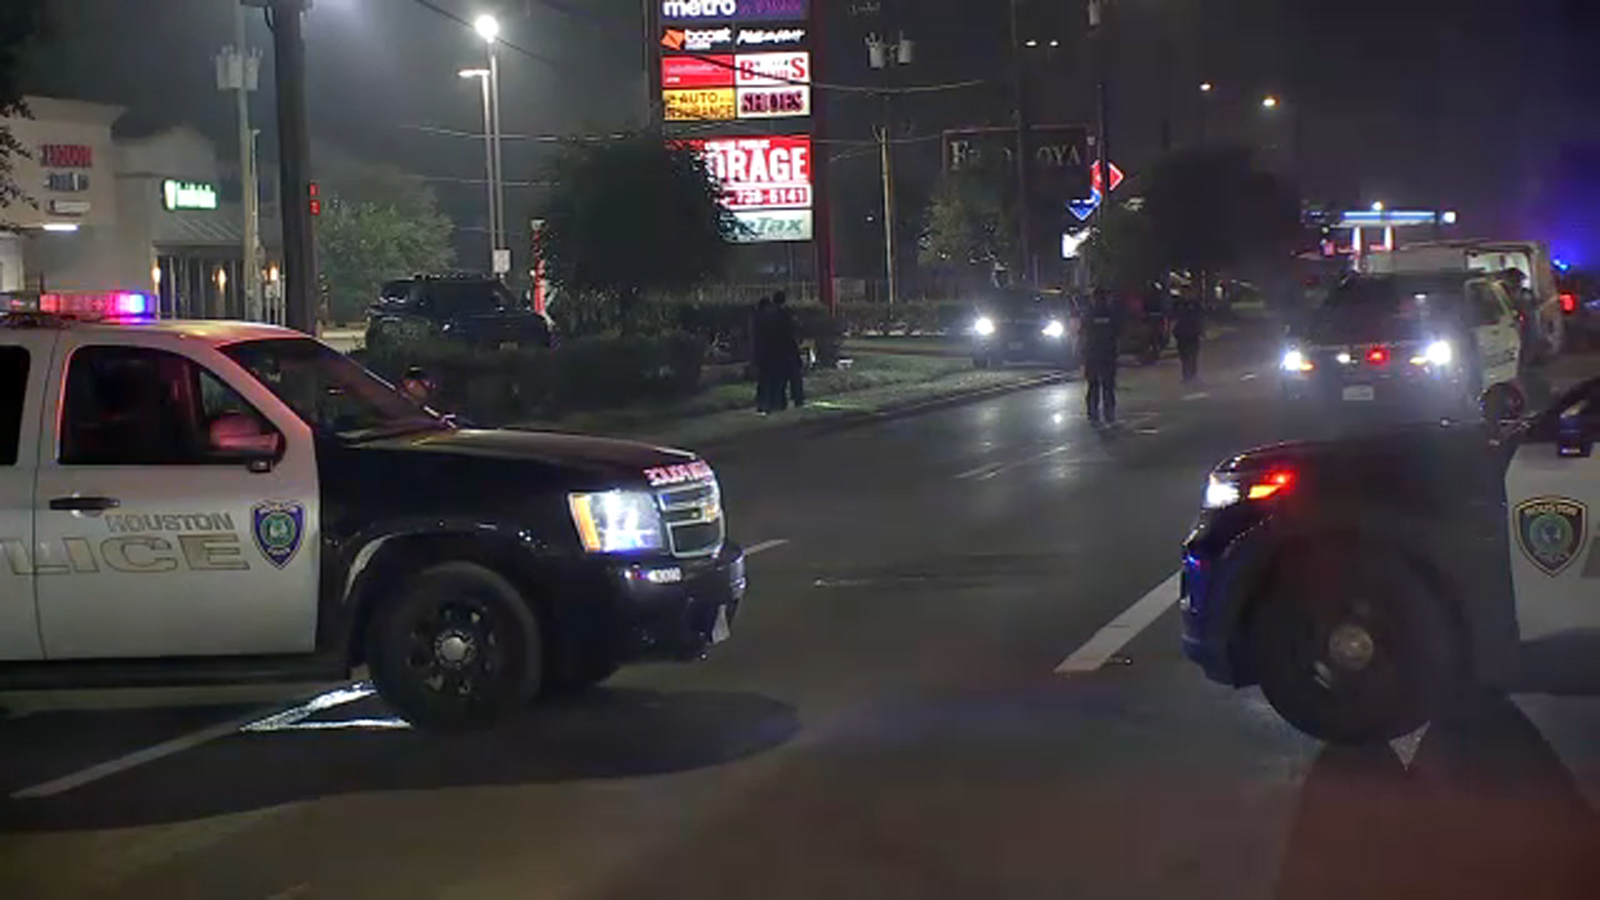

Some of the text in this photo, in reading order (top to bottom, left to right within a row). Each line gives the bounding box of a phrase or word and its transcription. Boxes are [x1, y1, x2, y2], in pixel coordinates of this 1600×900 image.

[663, 0, 736, 17] metro
[685, 28, 731, 42] boost
[680, 92, 718, 104] AUTO
[741, 91, 804, 114] SHOES
[106, 512, 235, 533] HOUSTON
